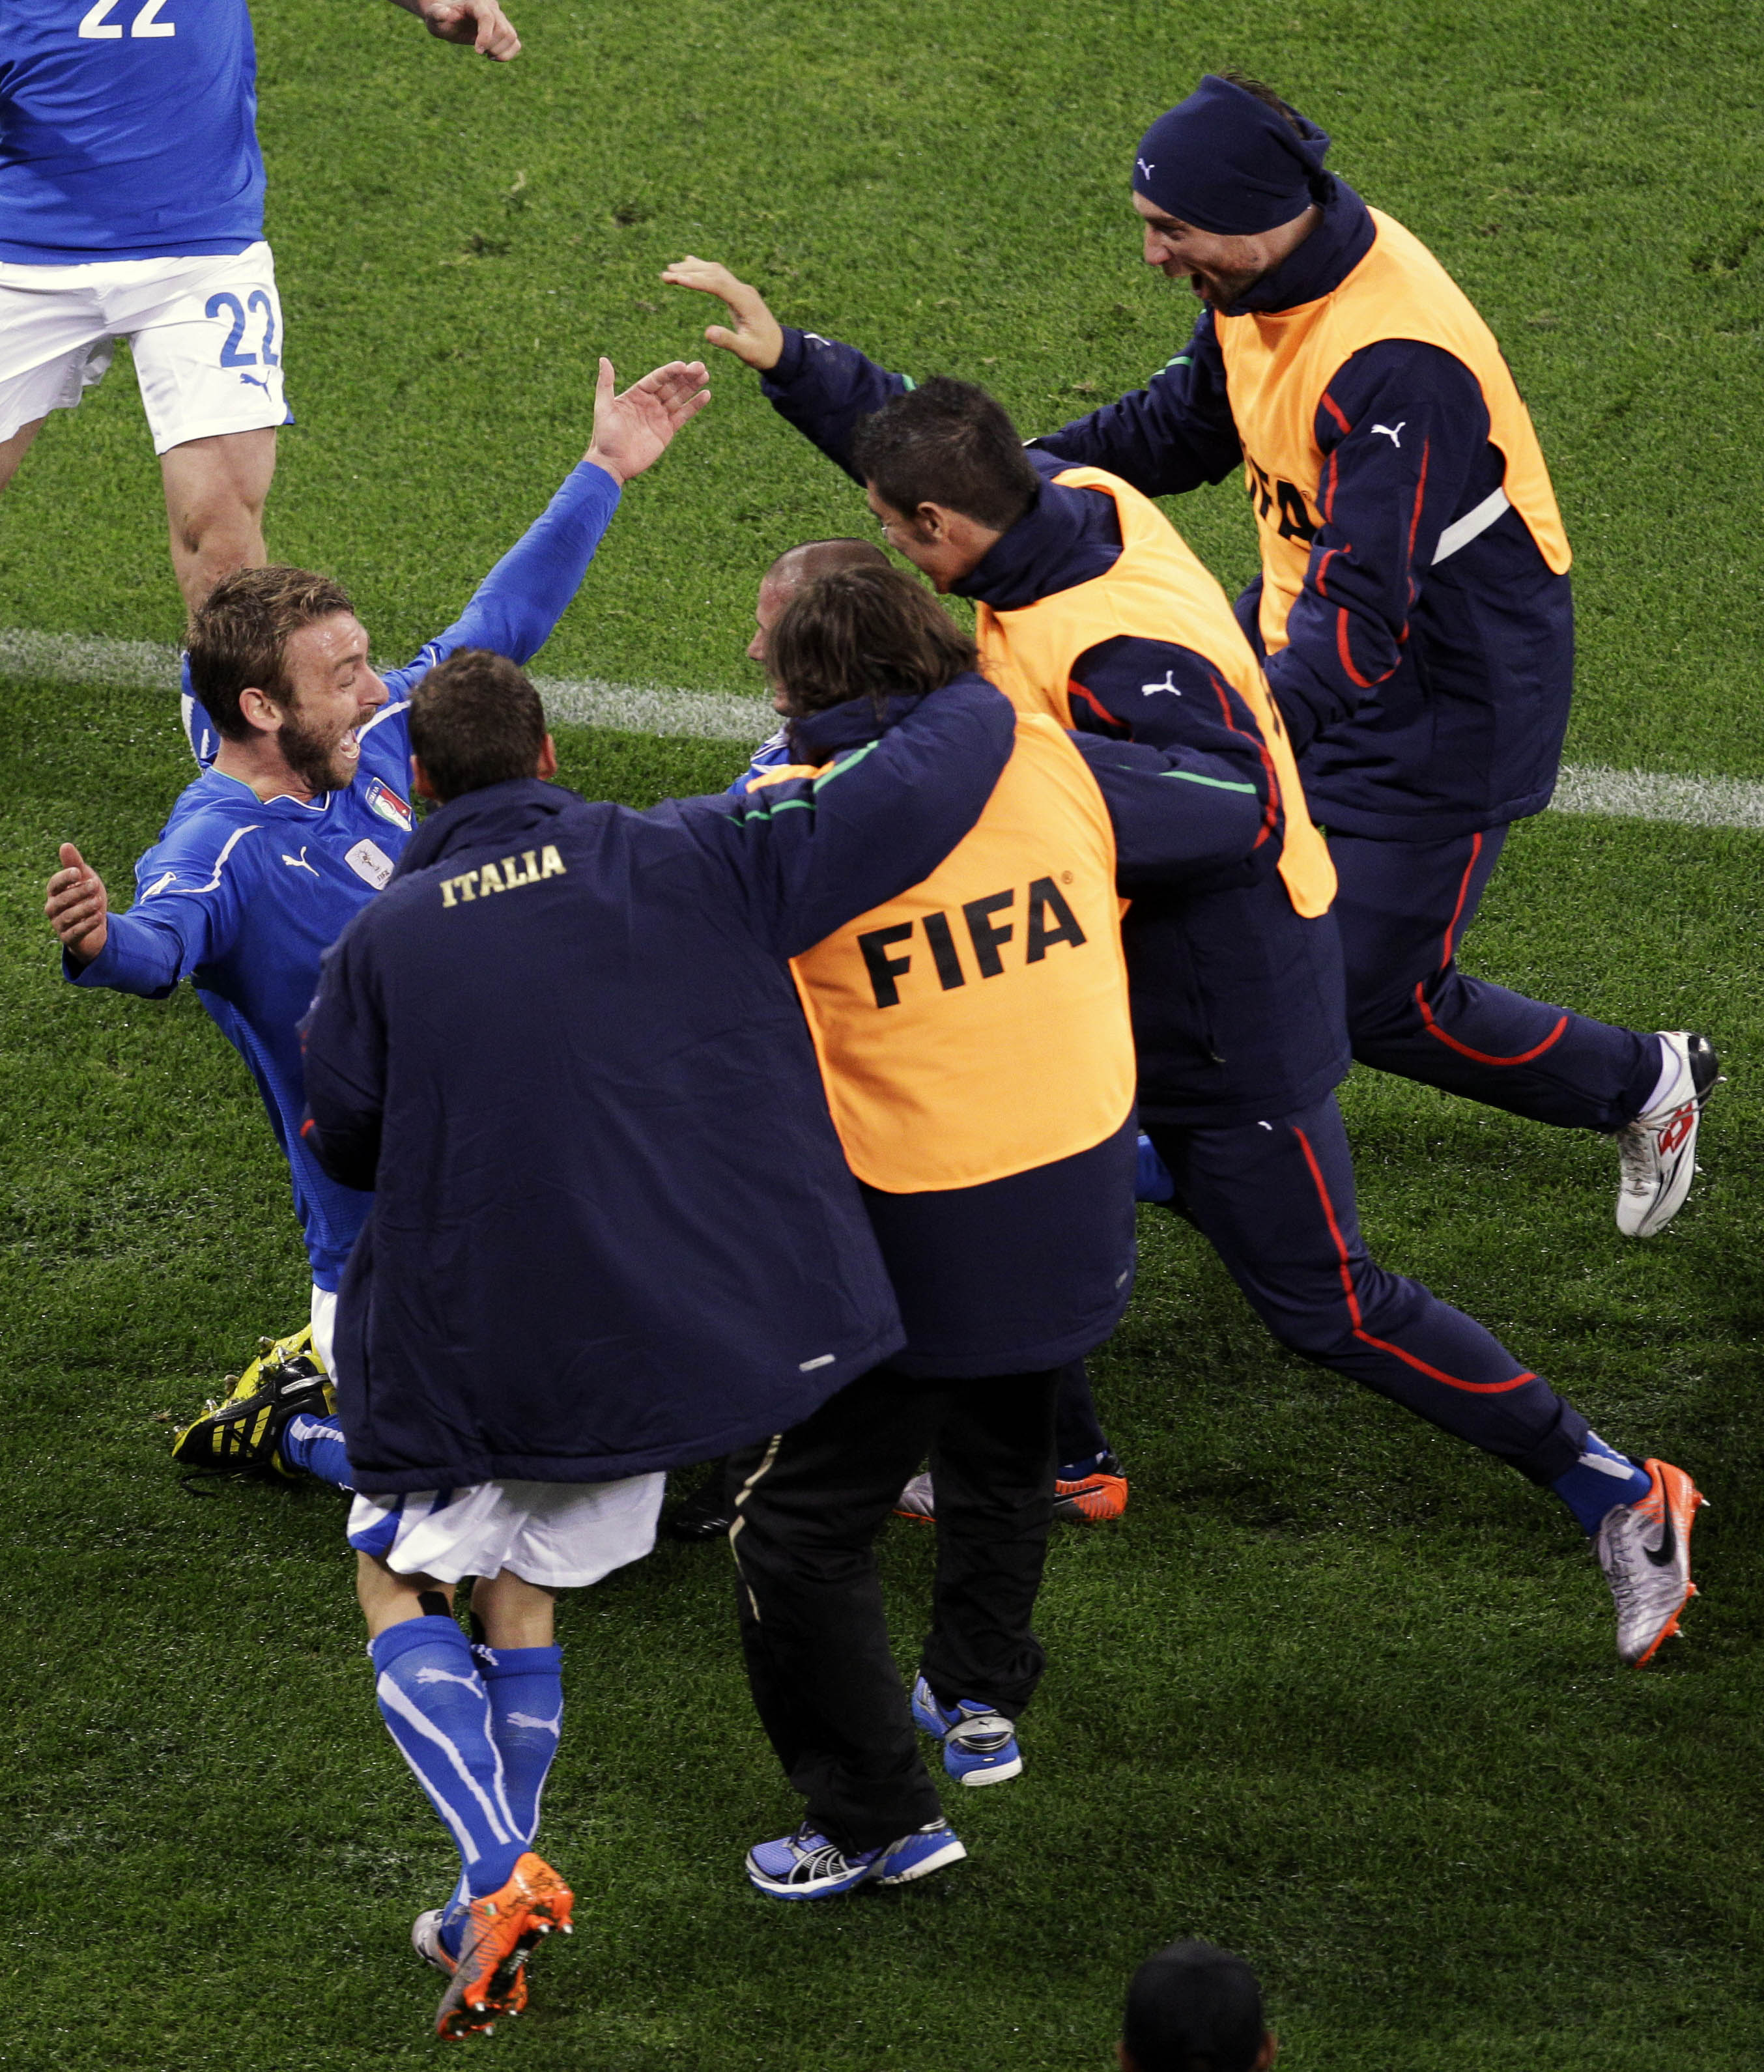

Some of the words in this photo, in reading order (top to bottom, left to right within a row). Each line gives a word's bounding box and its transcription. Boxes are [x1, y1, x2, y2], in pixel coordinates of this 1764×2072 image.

[205, 290, 279, 368] 22
[439, 844, 567, 909] ITALIA
[856, 875, 1088, 1009] FIFA
